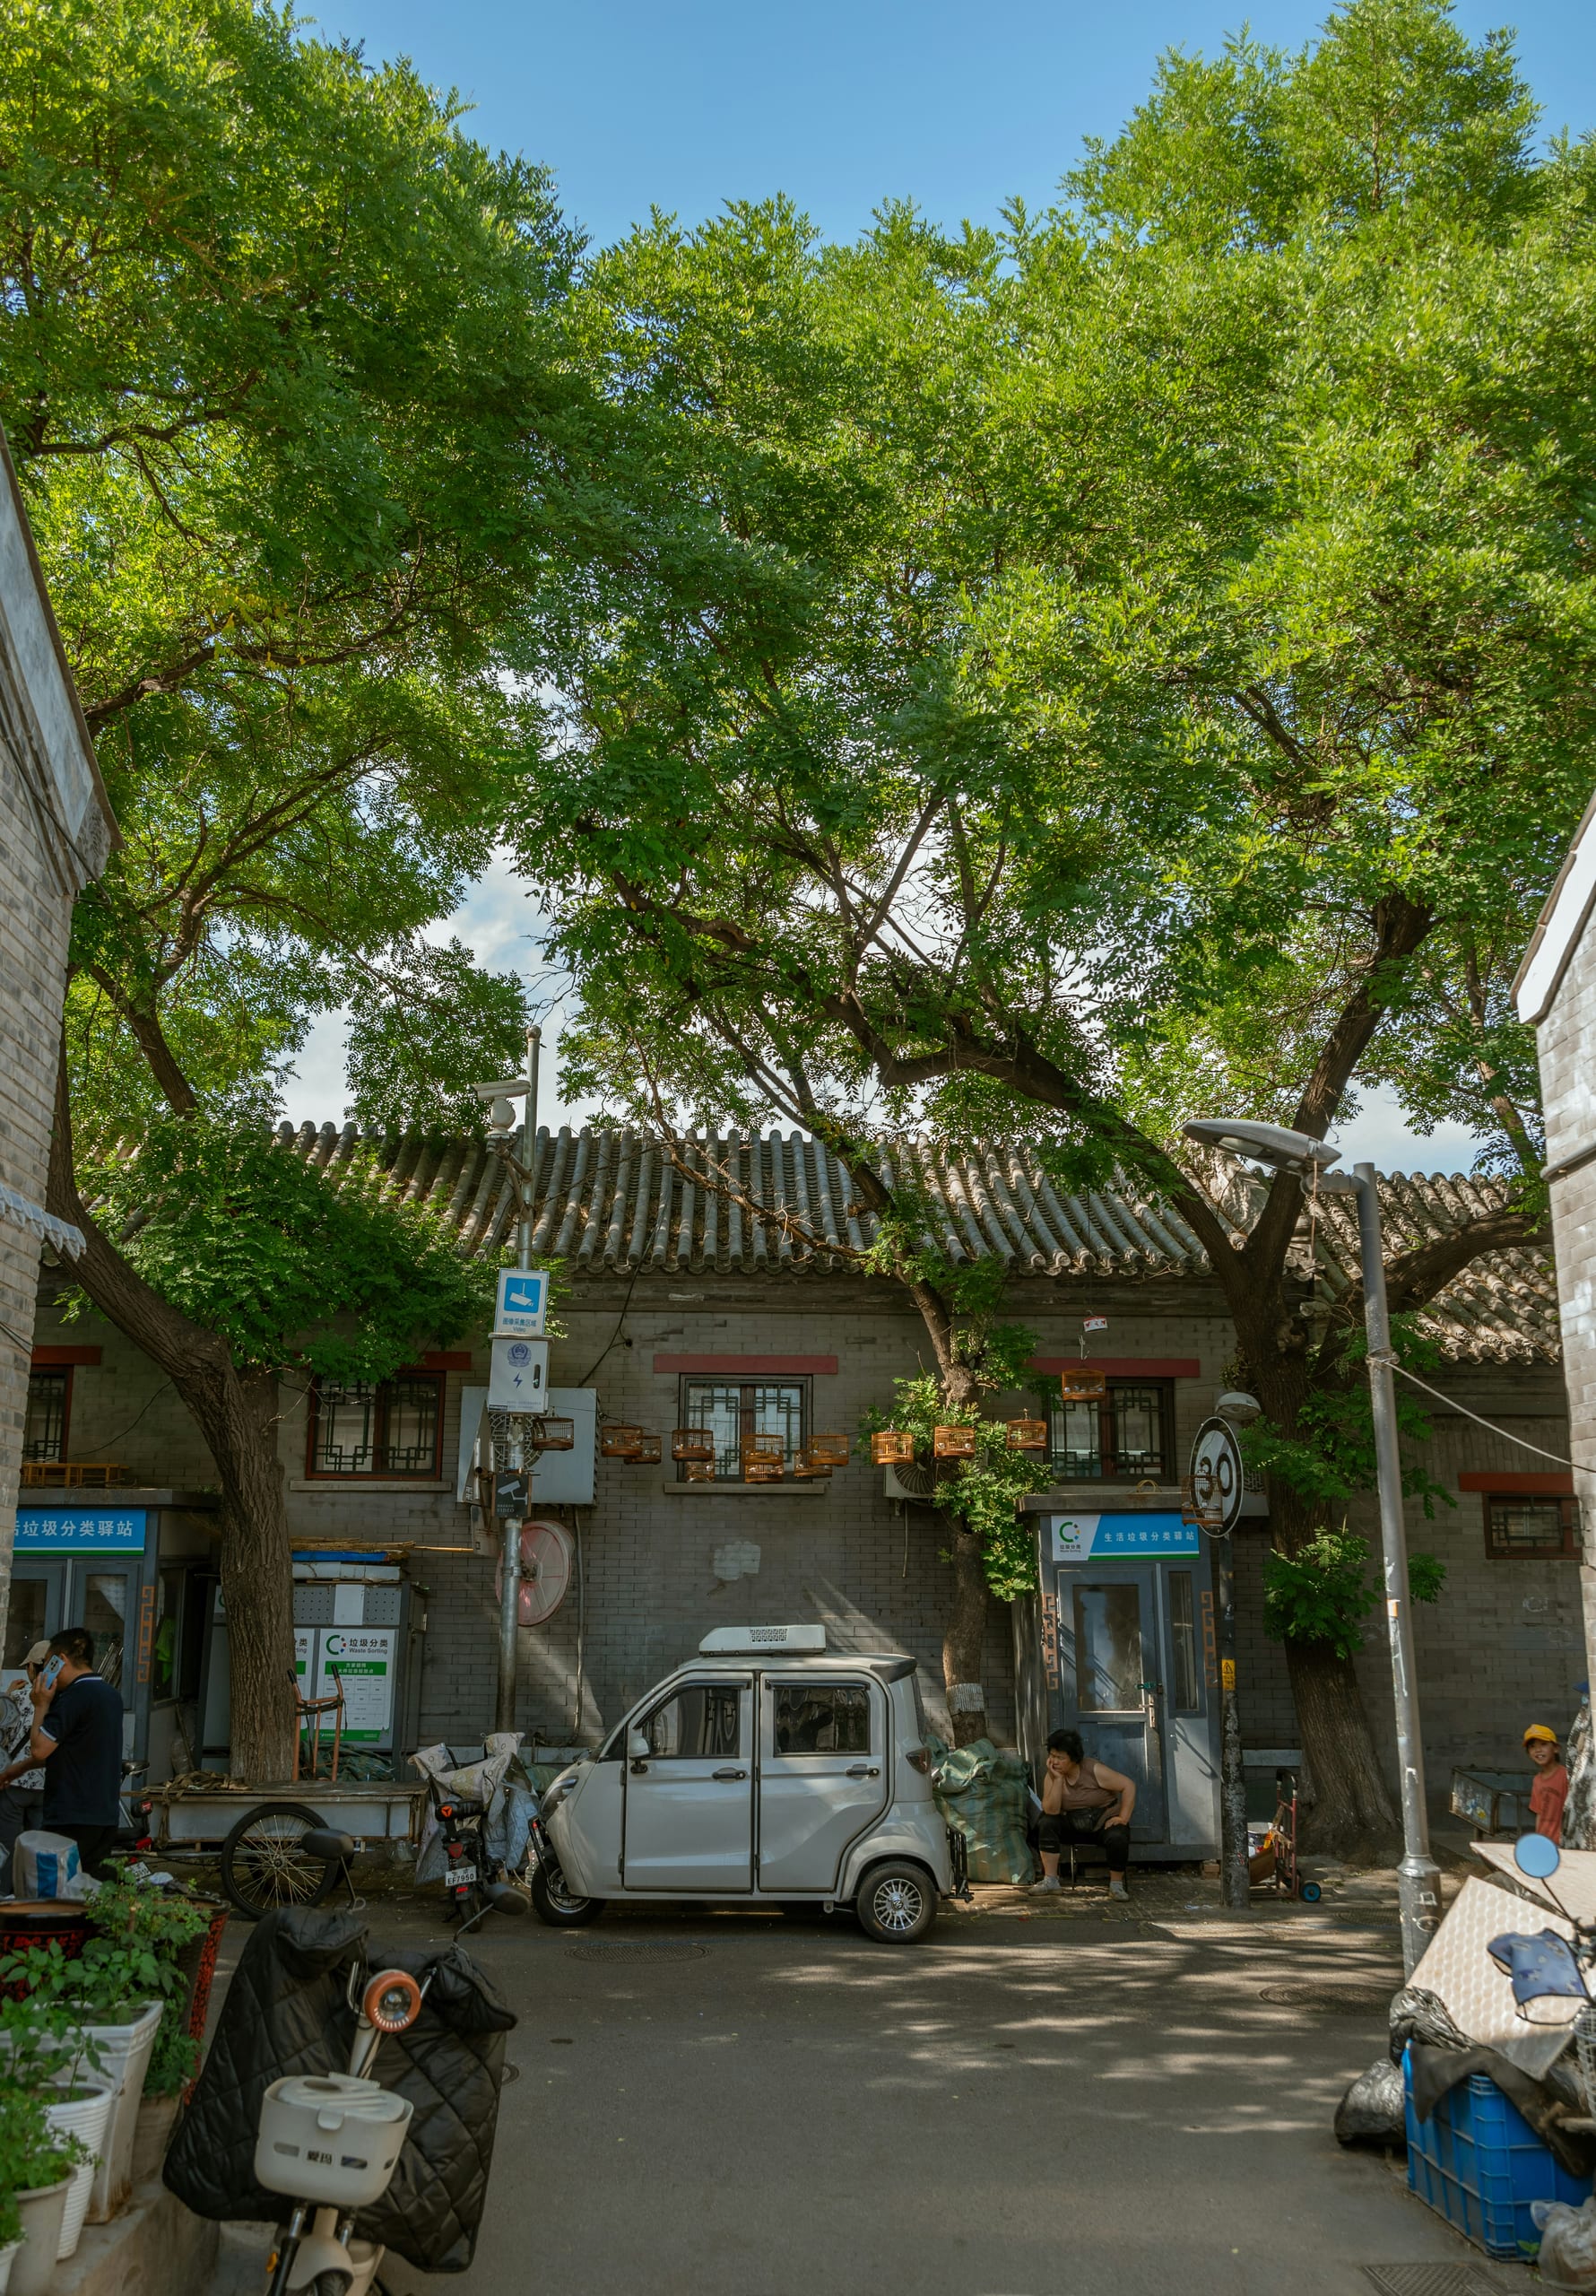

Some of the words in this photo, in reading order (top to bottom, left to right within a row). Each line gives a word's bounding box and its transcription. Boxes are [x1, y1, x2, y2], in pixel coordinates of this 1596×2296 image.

[1104, 1531, 1195, 1543] 生活垃圾分类驿站
[349, 1638, 388, 1648] 垃圾分类
[447, 1873, 474, 1884] EF7950
